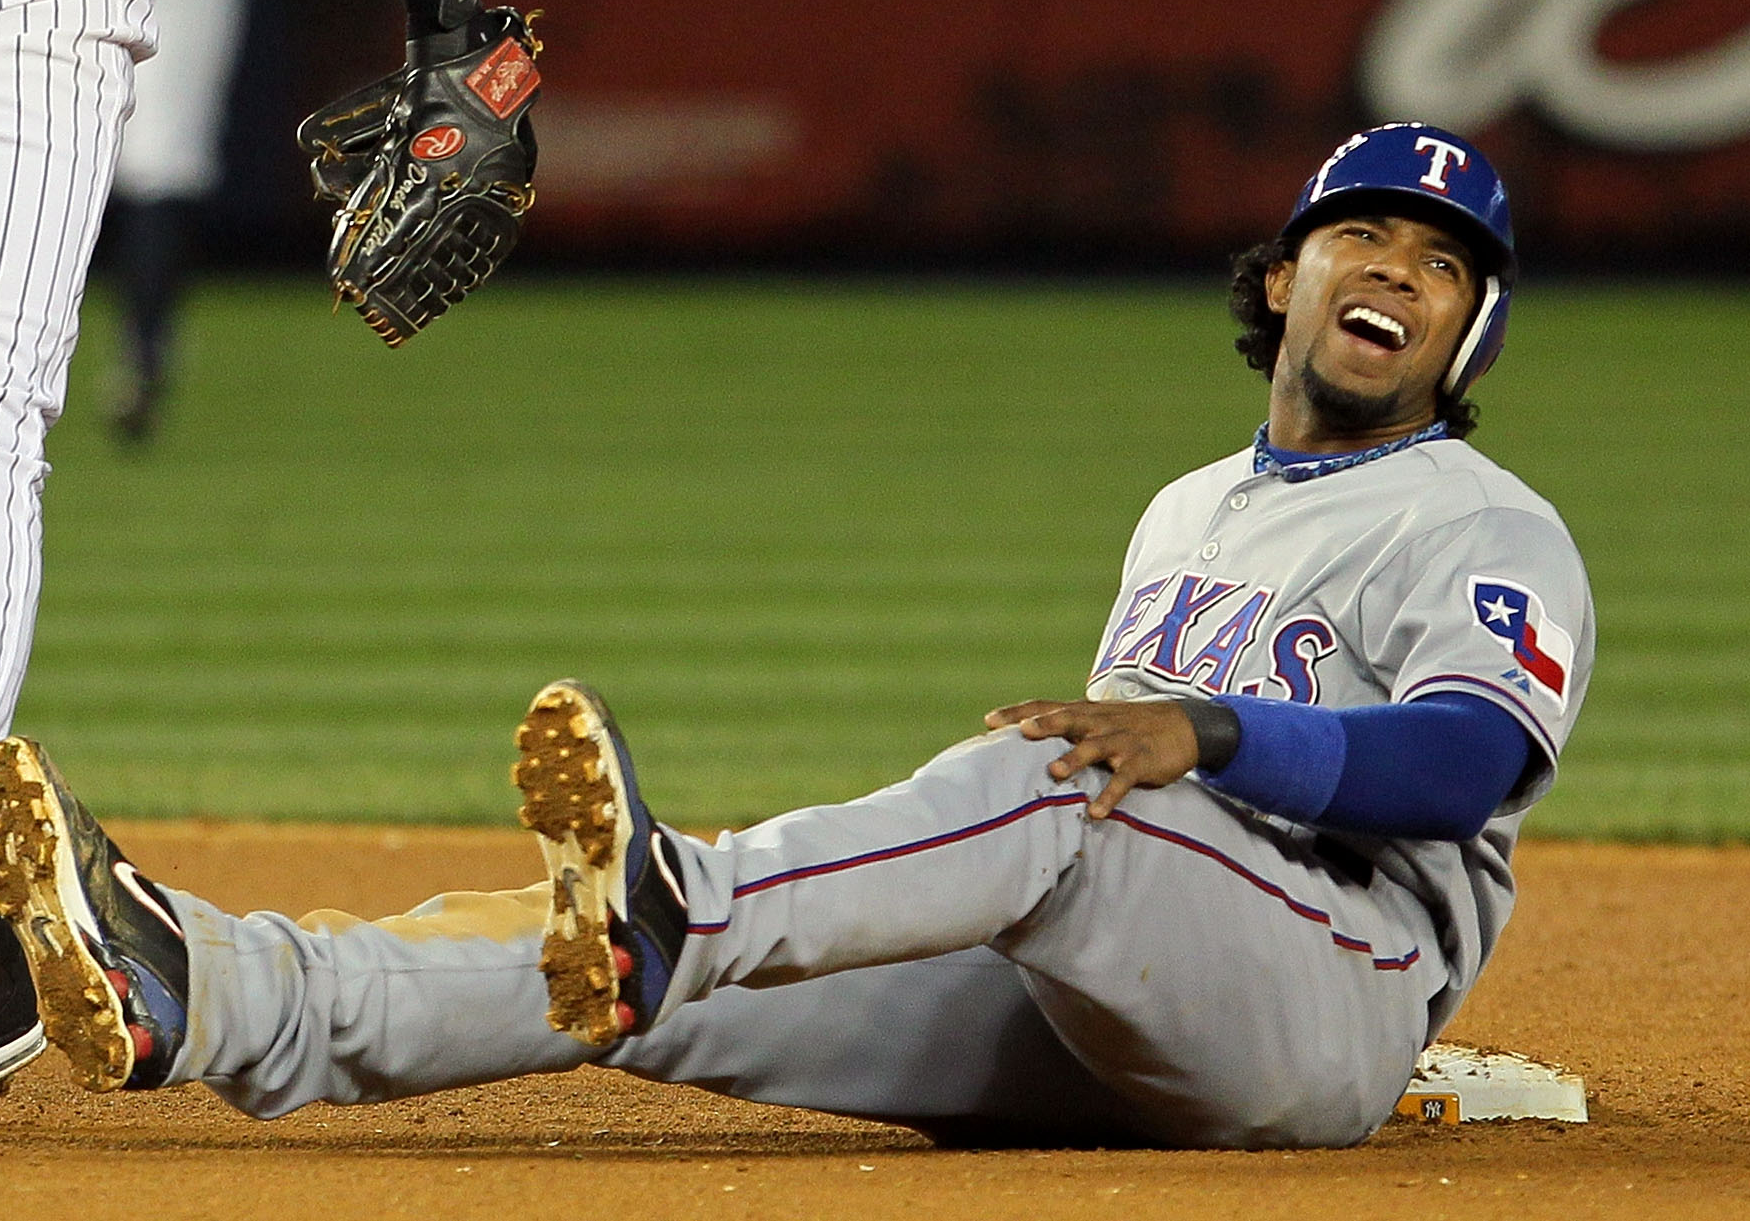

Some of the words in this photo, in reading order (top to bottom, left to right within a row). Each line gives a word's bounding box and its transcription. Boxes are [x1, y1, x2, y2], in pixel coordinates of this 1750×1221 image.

[388, 163, 428, 214] Derek
[1414, 136, 1470, 196] T
[1086, 570, 1338, 704] EXAS
